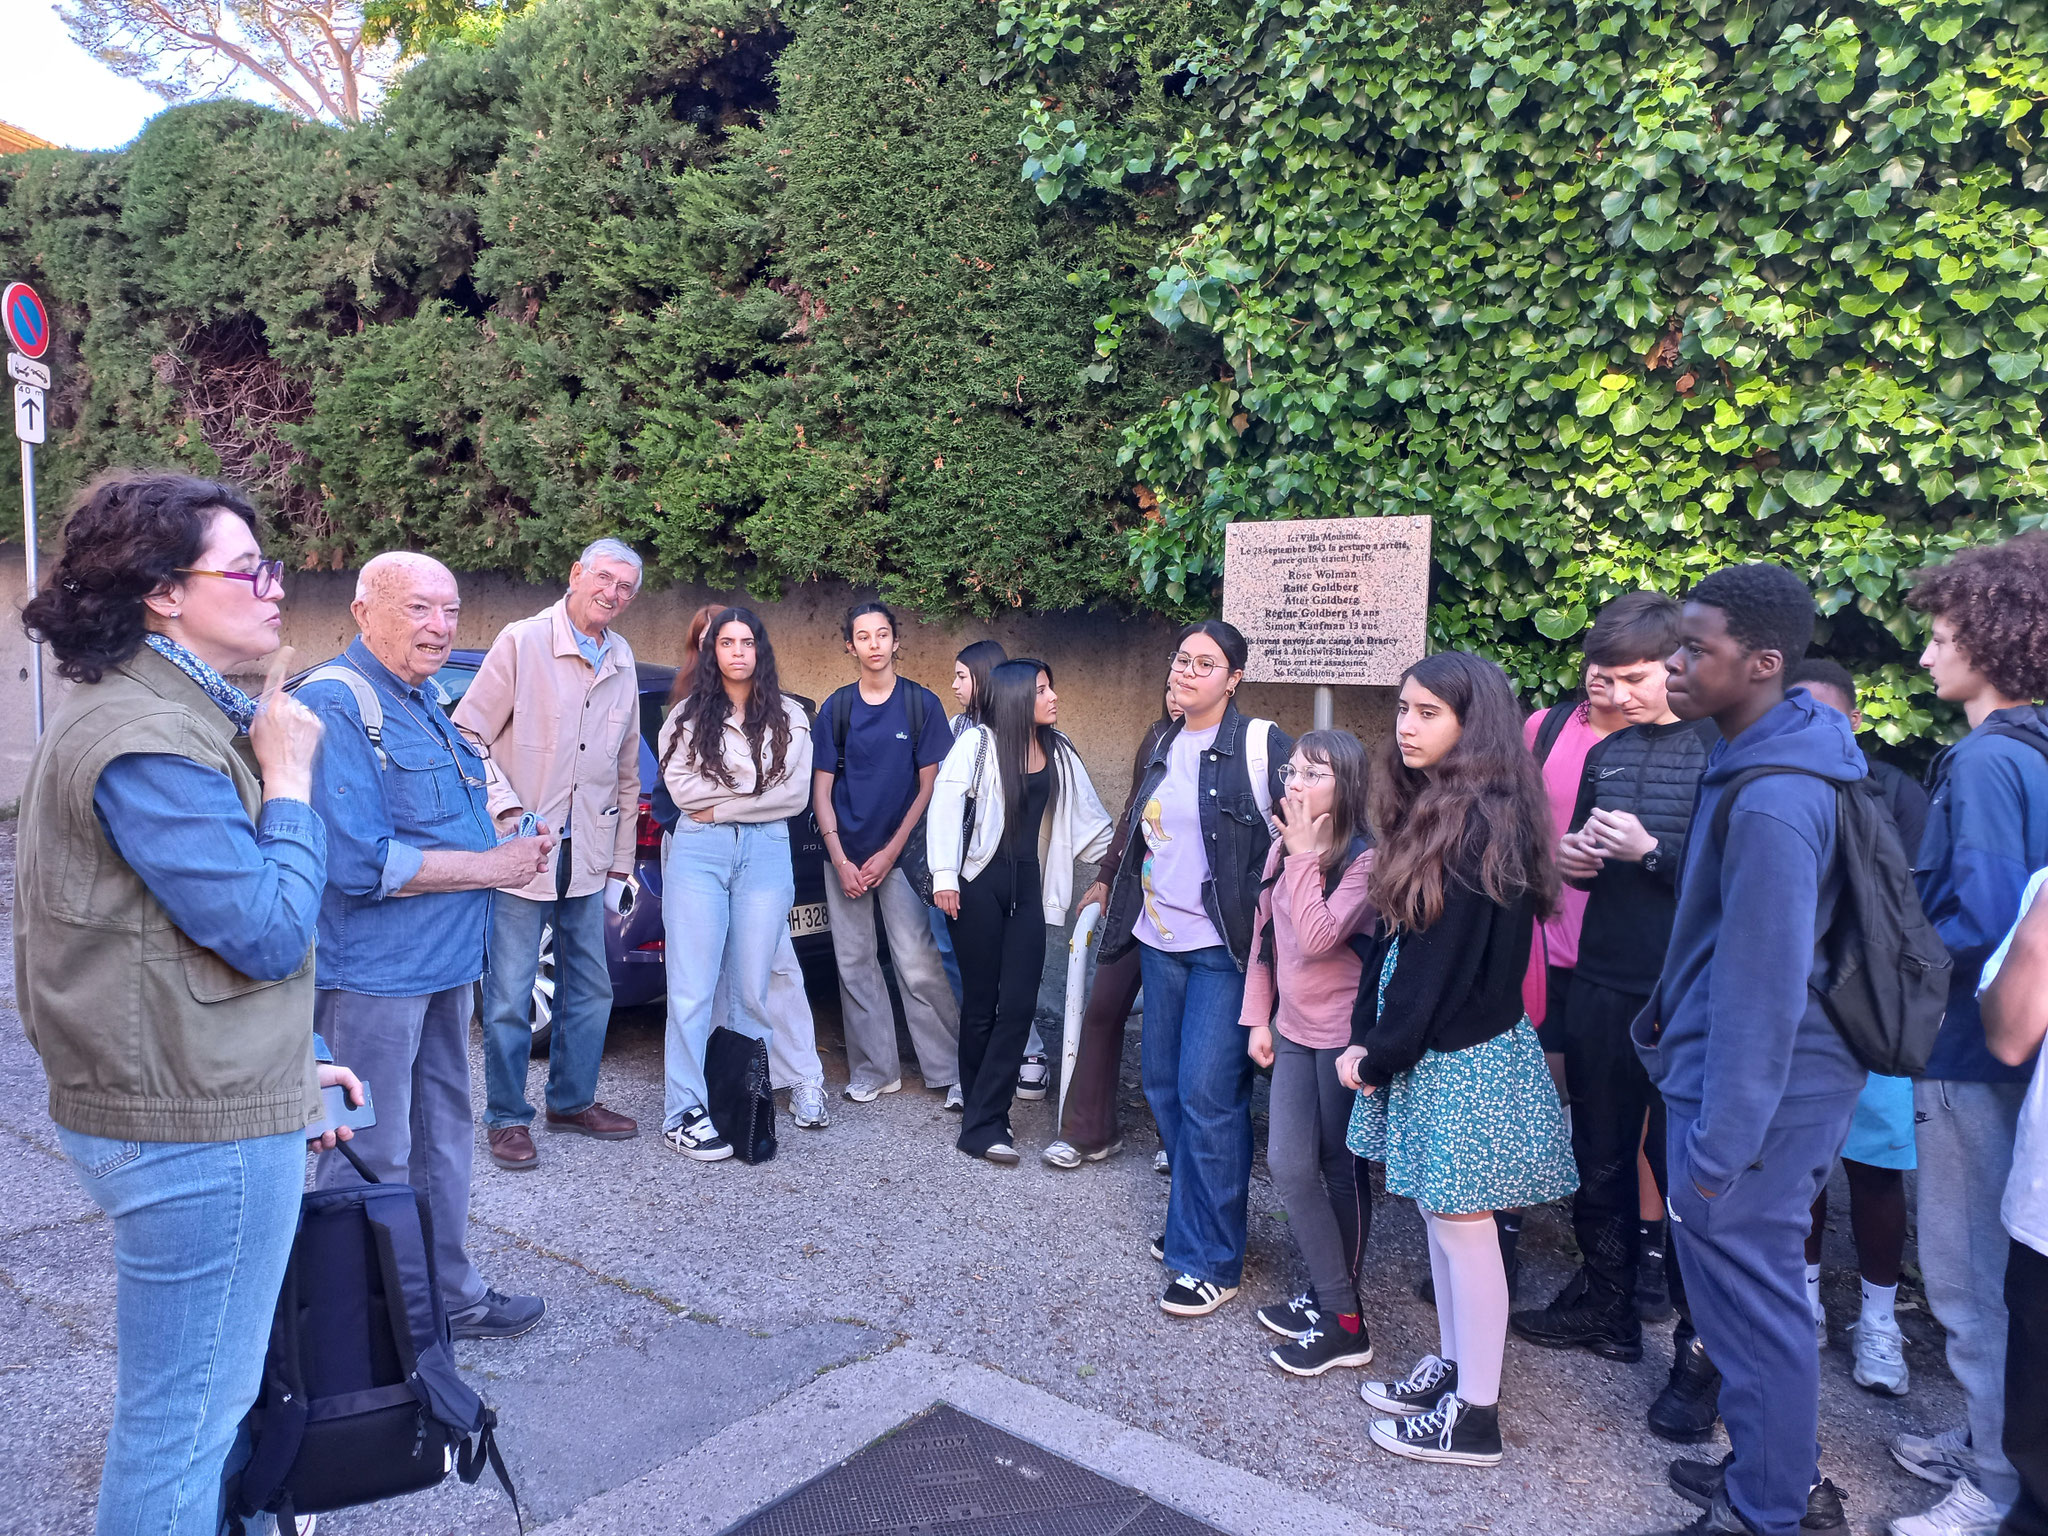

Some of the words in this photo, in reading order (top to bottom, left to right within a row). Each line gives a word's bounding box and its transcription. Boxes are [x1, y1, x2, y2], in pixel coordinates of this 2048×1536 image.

[18, 385, 31, 395] 40
[1287, 534, 1298, 542] Ici
[1300, 532, 1320, 542] Villa
[1240, 547, 1251, 556] Le
[1264, 545, 1306, 555] septembre
[1308, 543, 1326, 553] 1943
[1328, 543, 1336, 551] la
[1338, 542, 1371, 552] gestapo
[1273, 557, 1295, 566] parce
[1321, 554, 1349, 563] étaient
[1288, 570, 1312, 580] Rose
[1316, 569, 1357, 579] Wolman
[1312, 582, 1359, 593] Goldberg
[1312, 595, 1360, 605] Goldberg
[1265, 609, 1298, 619] Régine
[1301, 608, 1348, 619] Goldberg
[1351, 609, 1361, 617] 14
[1265, 621, 1296, 631] Simon
[1299, 621, 1345, 630] Kaufman
[1349, 621, 1359, 630] 13
[1256, 636, 1280, 645] furent
[1283, 636, 1313, 646] envoyés
[1316, 637, 1326, 645] au
[1328, 638, 1351, 646] camp
[1354, 636, 1364, 645] de
[1366, 636, 1399, 646] Drancy
[1264, 647, 1282, 656] puis
[1291, 647, 1374, 656] Auschwitz-Birkenau
[1273, 657, 1292, 666] Tous
[1310, 657, 1322, 666] été
[1287, 668, 1298, 677] les
[1300, 669, 1335, 678] oublions
[1337, 669, 1366, 679] jamais
[802, 843, 823, 851] POL
